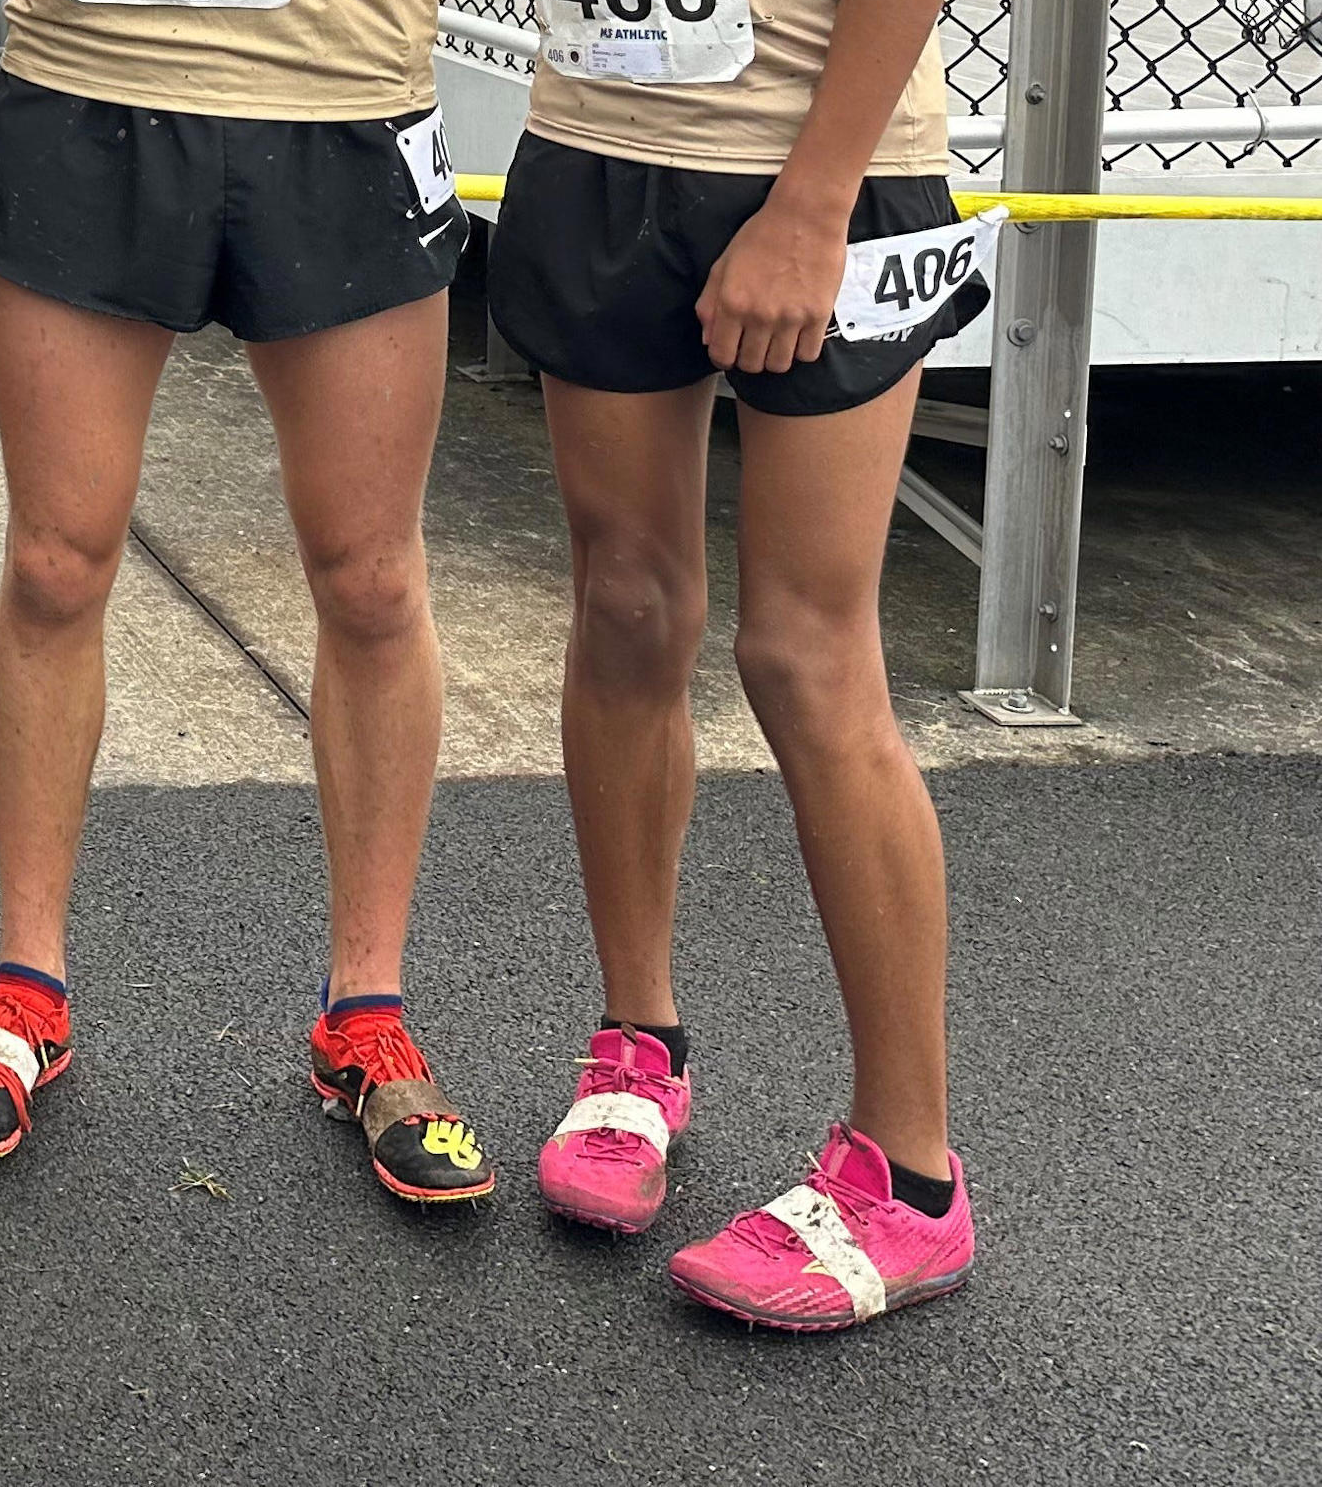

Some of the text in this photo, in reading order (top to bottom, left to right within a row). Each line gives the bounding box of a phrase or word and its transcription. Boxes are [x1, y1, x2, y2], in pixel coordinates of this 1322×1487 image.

[615, 28, 668, 41] ATHLETIC
[547, 49, 565, 63] 406
[873, 235, 975, 312] 406
